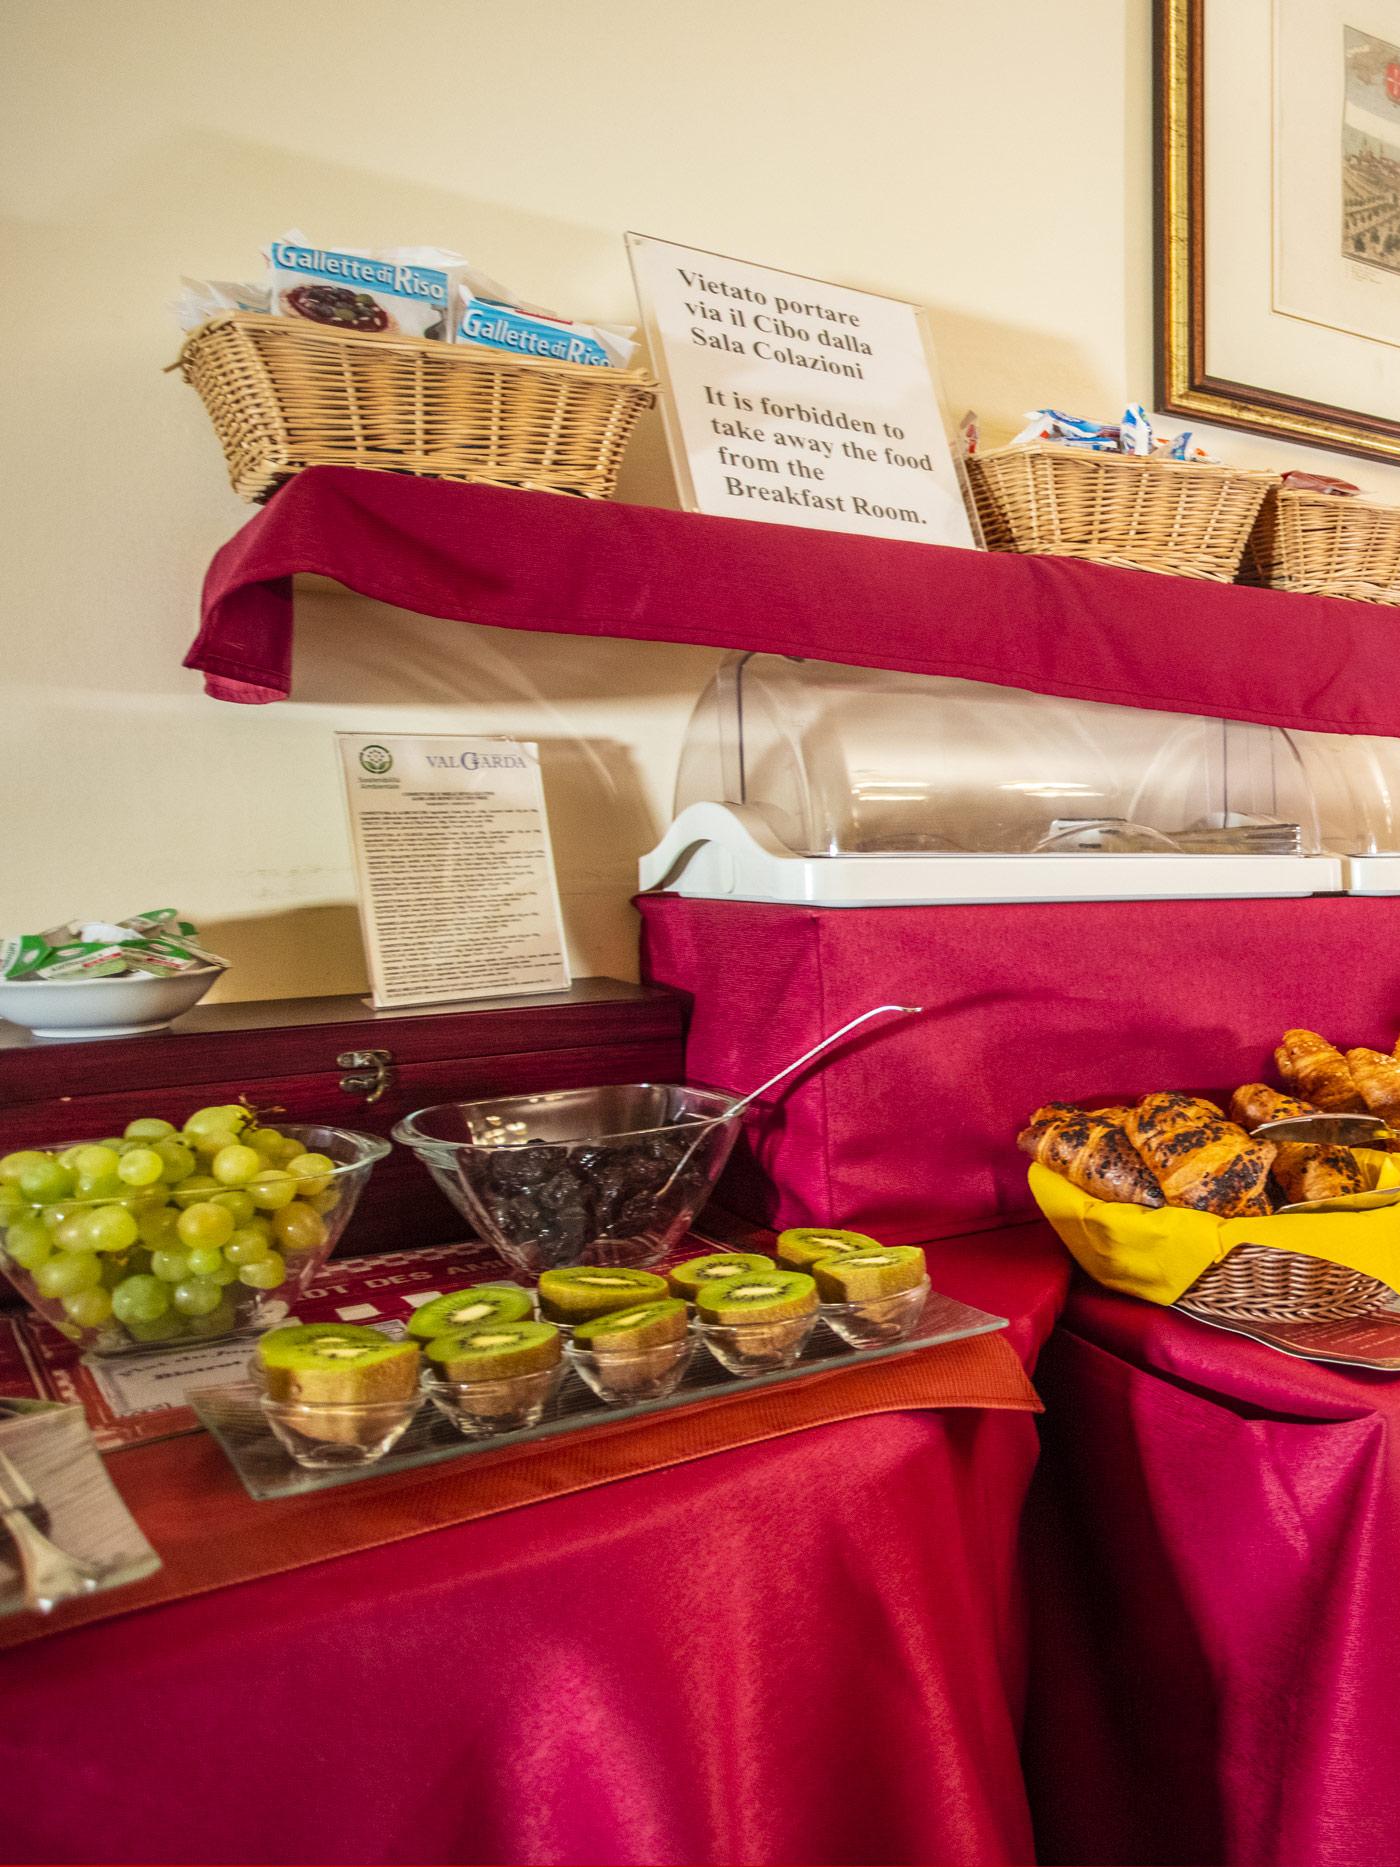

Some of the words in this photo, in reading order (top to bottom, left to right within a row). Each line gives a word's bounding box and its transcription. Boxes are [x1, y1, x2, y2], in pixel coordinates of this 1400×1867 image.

[276, 244, 373, 282] Gallette
[375, 267, 392, 284] di
[393, 266, 445, 299] Riso
[676, 267, 767, 306] Vietato
[774, 294, 861, 328] portare
[462, 308, 549, 356] Gallette
[550, 340, 566, 359] di
[684, 302, 723, 323] via
[730, 307, 746, 328] il
[753, 313, 811, 343] Cibo
[818, 328, 873, 356] dalla
[691, 326, 745, 355] Sala
[753, 340, 864, 380] Colazioni
[703, 385, 726, 407] It
[735, 391, 753, 413] is
[761, 397, 877, 436] forbidden
[883, 421, 905, 441] to
[711, 416, 766, 442] take
[773, 429, 834, 459] away
[842, 440, 878, 462] the
[884, 447, 934, 472] food
[718, 446, 780, 474] from
[787, 456, 825, 481] the
[723, 475, 845, 512] Breakfast
[852, 495, 928, 525] Room.
[363, 1270, 433, 1289] DES
